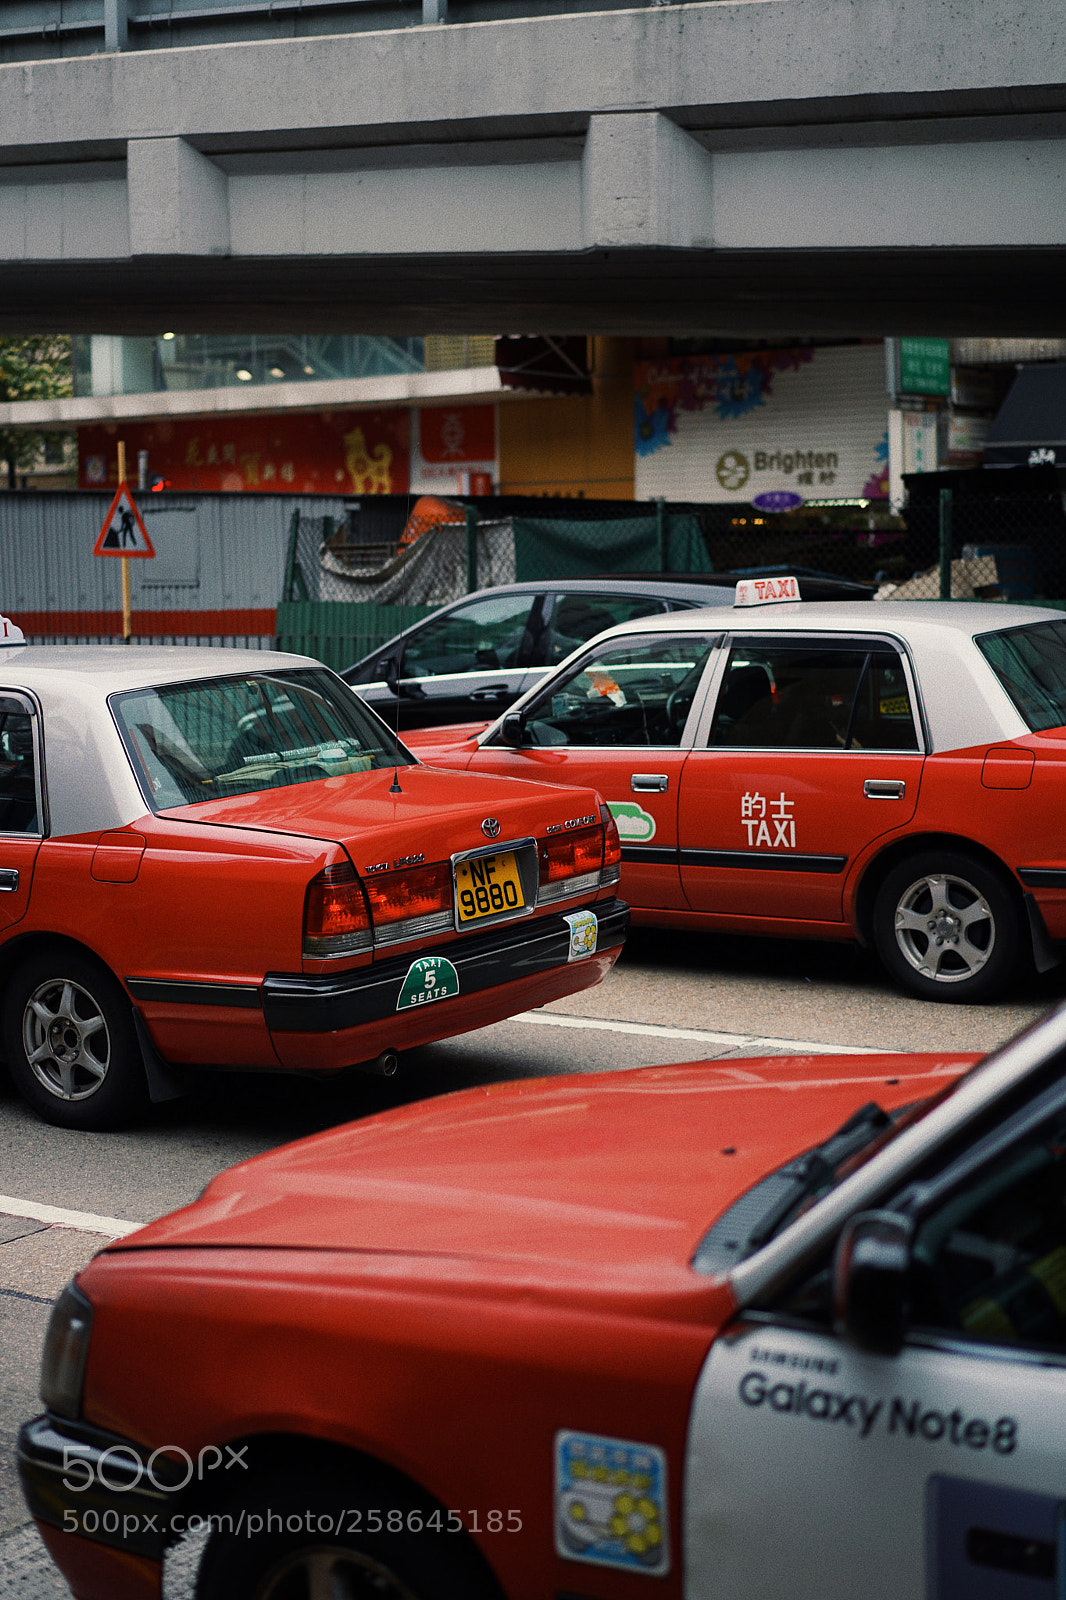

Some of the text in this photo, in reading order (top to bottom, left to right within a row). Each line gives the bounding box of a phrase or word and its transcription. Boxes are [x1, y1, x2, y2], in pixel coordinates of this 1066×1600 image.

[754, 450, 839, 474] Brighten
[754, 579, 796, 600] TAXI
[741, 792, 795, 819] 的士
[741, 820, 796, 848] TAXI
[469, 856, 497, 887] NF
[460, 880, 518, 917] 9880
[415, 958, 442, 972] TAXI
[424, 970, 437, 989] 5
[410, 986, 448, 1004] SEATS
[738, 1371, 1018, 1456] Galaxy Note8
